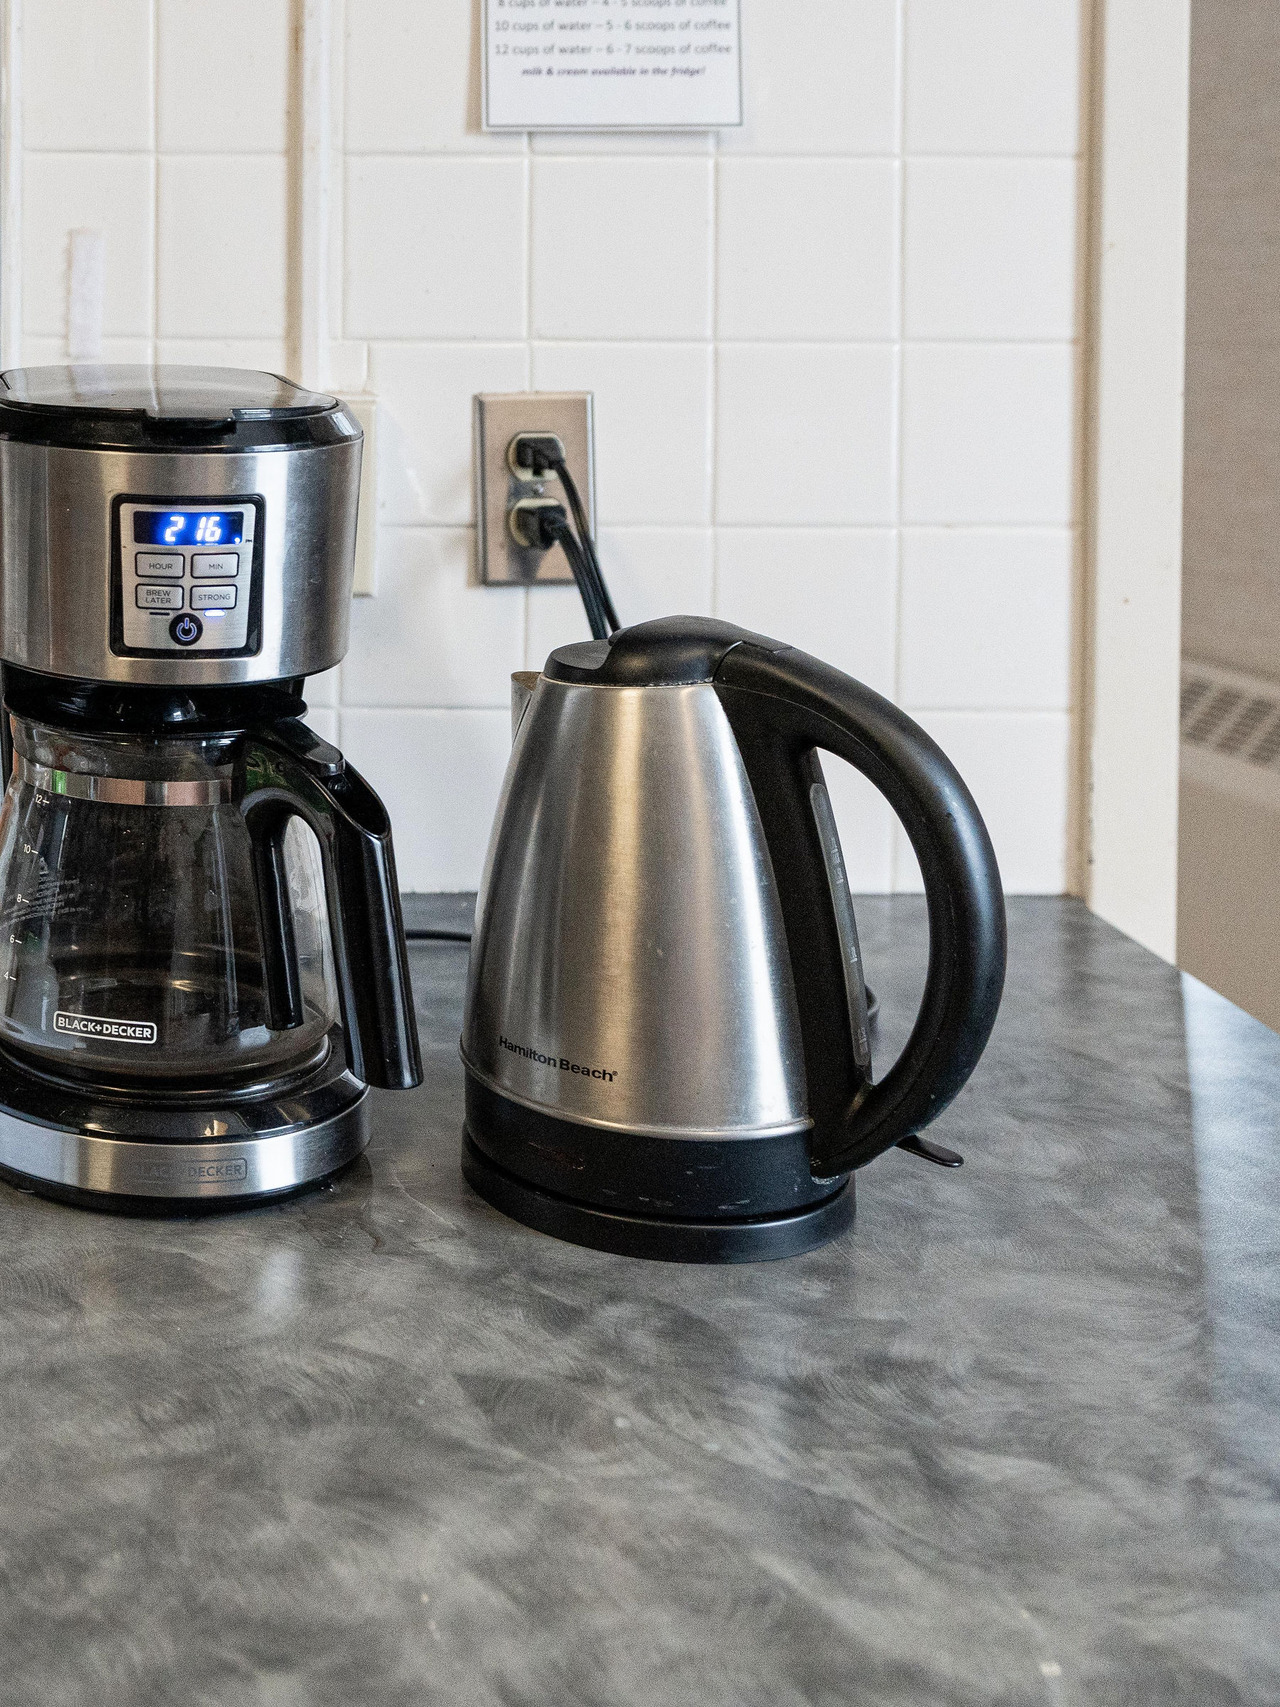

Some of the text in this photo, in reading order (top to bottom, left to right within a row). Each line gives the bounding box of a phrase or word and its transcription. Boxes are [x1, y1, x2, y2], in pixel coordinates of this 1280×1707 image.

[495, 21, 509, 31] 10
[512, 22, 539, 33] cups
[542, 20, 555, 31] of
[558, 22, 591, 31] water
[635, 22, 676, 32] scoops
[678, 20, 692, 31] of
[694, 20, 731, 31] coffee
[495, 45, 509, 55] 12
[512, 46, 539, 57] cups
[542, 44, 555, 55] of
[558, 46, 591, 55] water
[635, 46, 676, 56] scoops
[678, 44, 692, 55] of
[694, 44, 731, 55] coffee
[148, 562, 173, 570] HOUR
[208, 562, 224, 570] MIN
[146, 589, 171, 597] BREW
[198, 593, 231, 601] STRONG
[145, 597, 172, 605] LATER
[35, 794, 43, 804] 12
[23, 844, 31, 854] 10
[16, 893, 22, 903] 8
[9, 934, 15, 943] 6
[3, 971, 9, 980] 4
[57, 1016, 152, 1038] BLACK+DECKER
[499, 1035, 557, 1068] Hamilton
